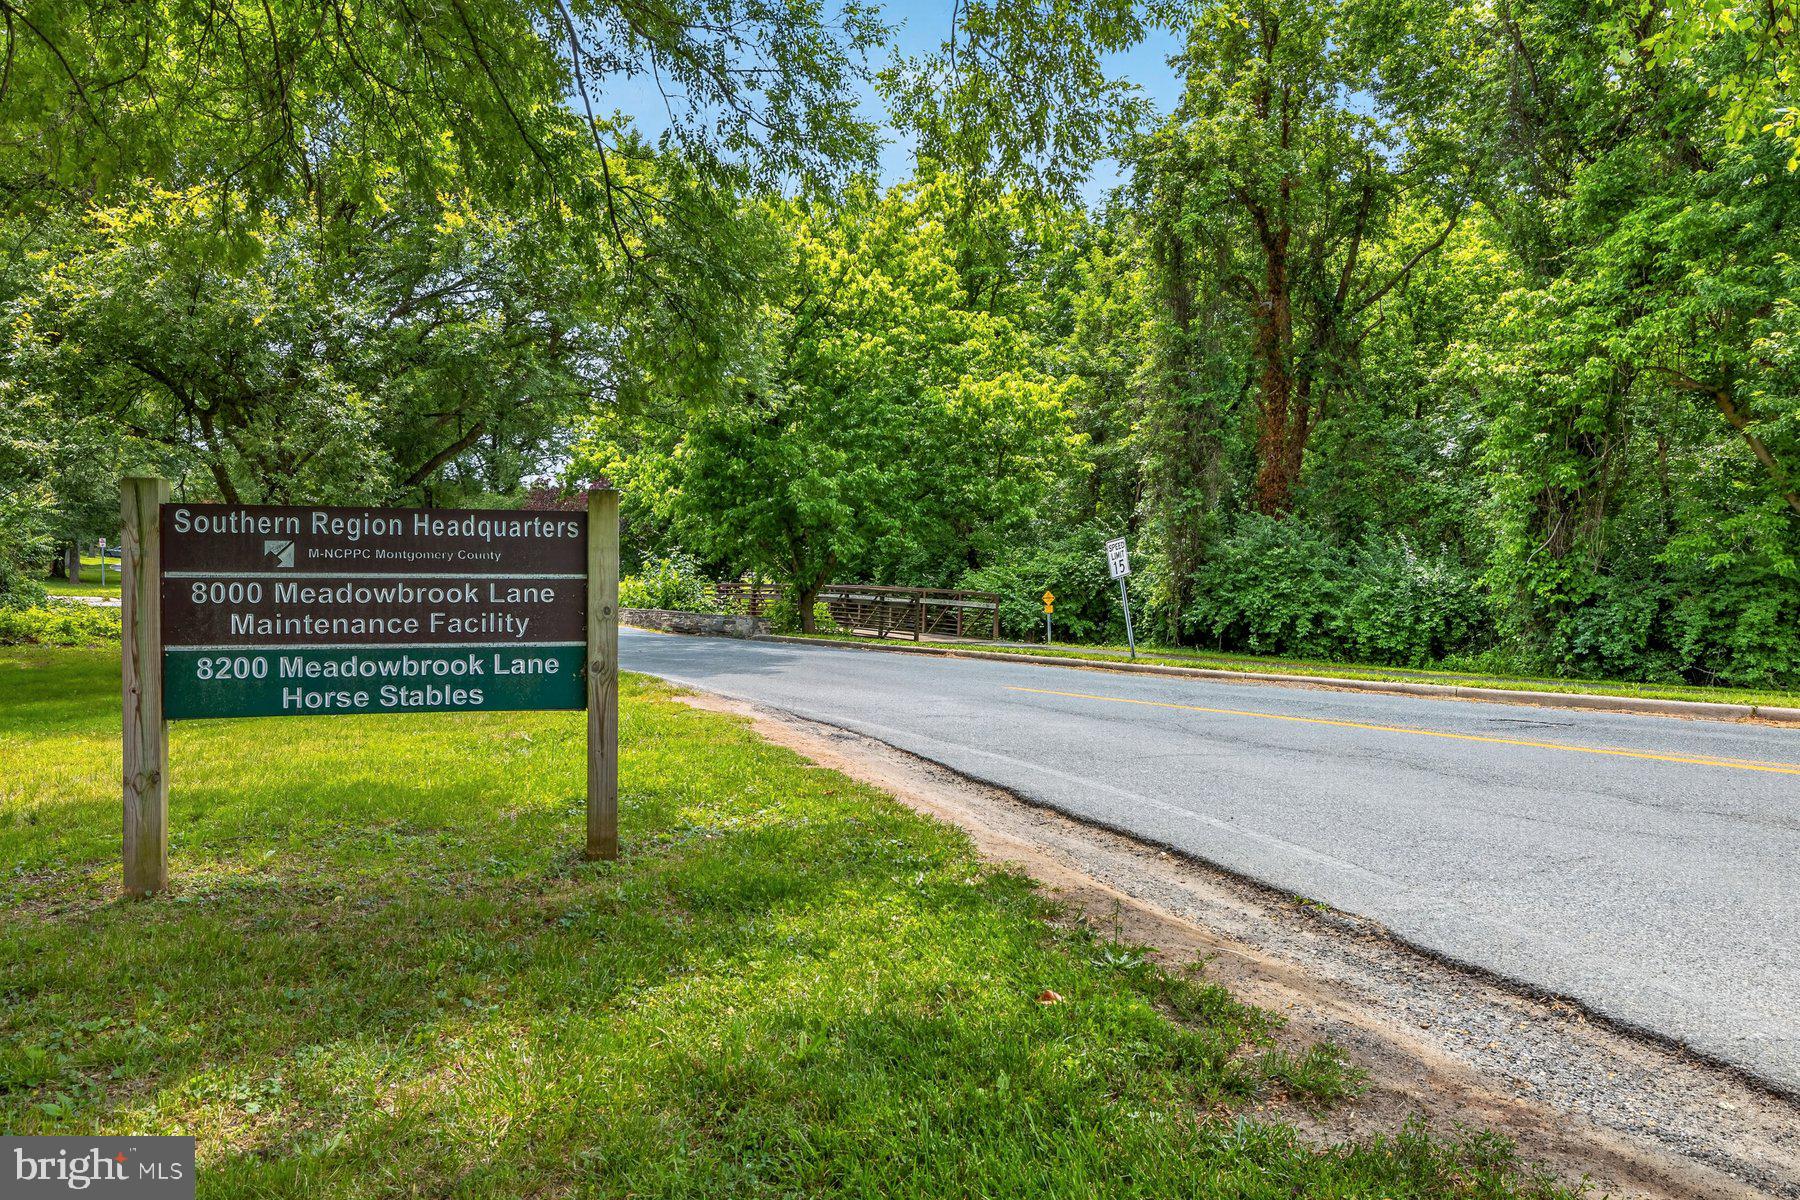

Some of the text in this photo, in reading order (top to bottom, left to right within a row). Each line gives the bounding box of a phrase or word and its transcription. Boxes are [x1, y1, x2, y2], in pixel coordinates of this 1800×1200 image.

[174, 508, 579, 543] Southern Region Headquarters
[308, 548, 501, 562] M-NCPPC Montgomery County
[1109, 541, 1125, 552] SPEED
[1111, 550, 1124, 560] LIMIT
[1113, 559, 1125, 574] 15
[191, 581, 555, 604] 8000 Meadowbrook Lane
[231, 612, 530, 638] Maintenance Facility
[196, 653, 560, 680] 8200 Meadowbrook Lane
[282, 684, 484, 709] Horse Stables
